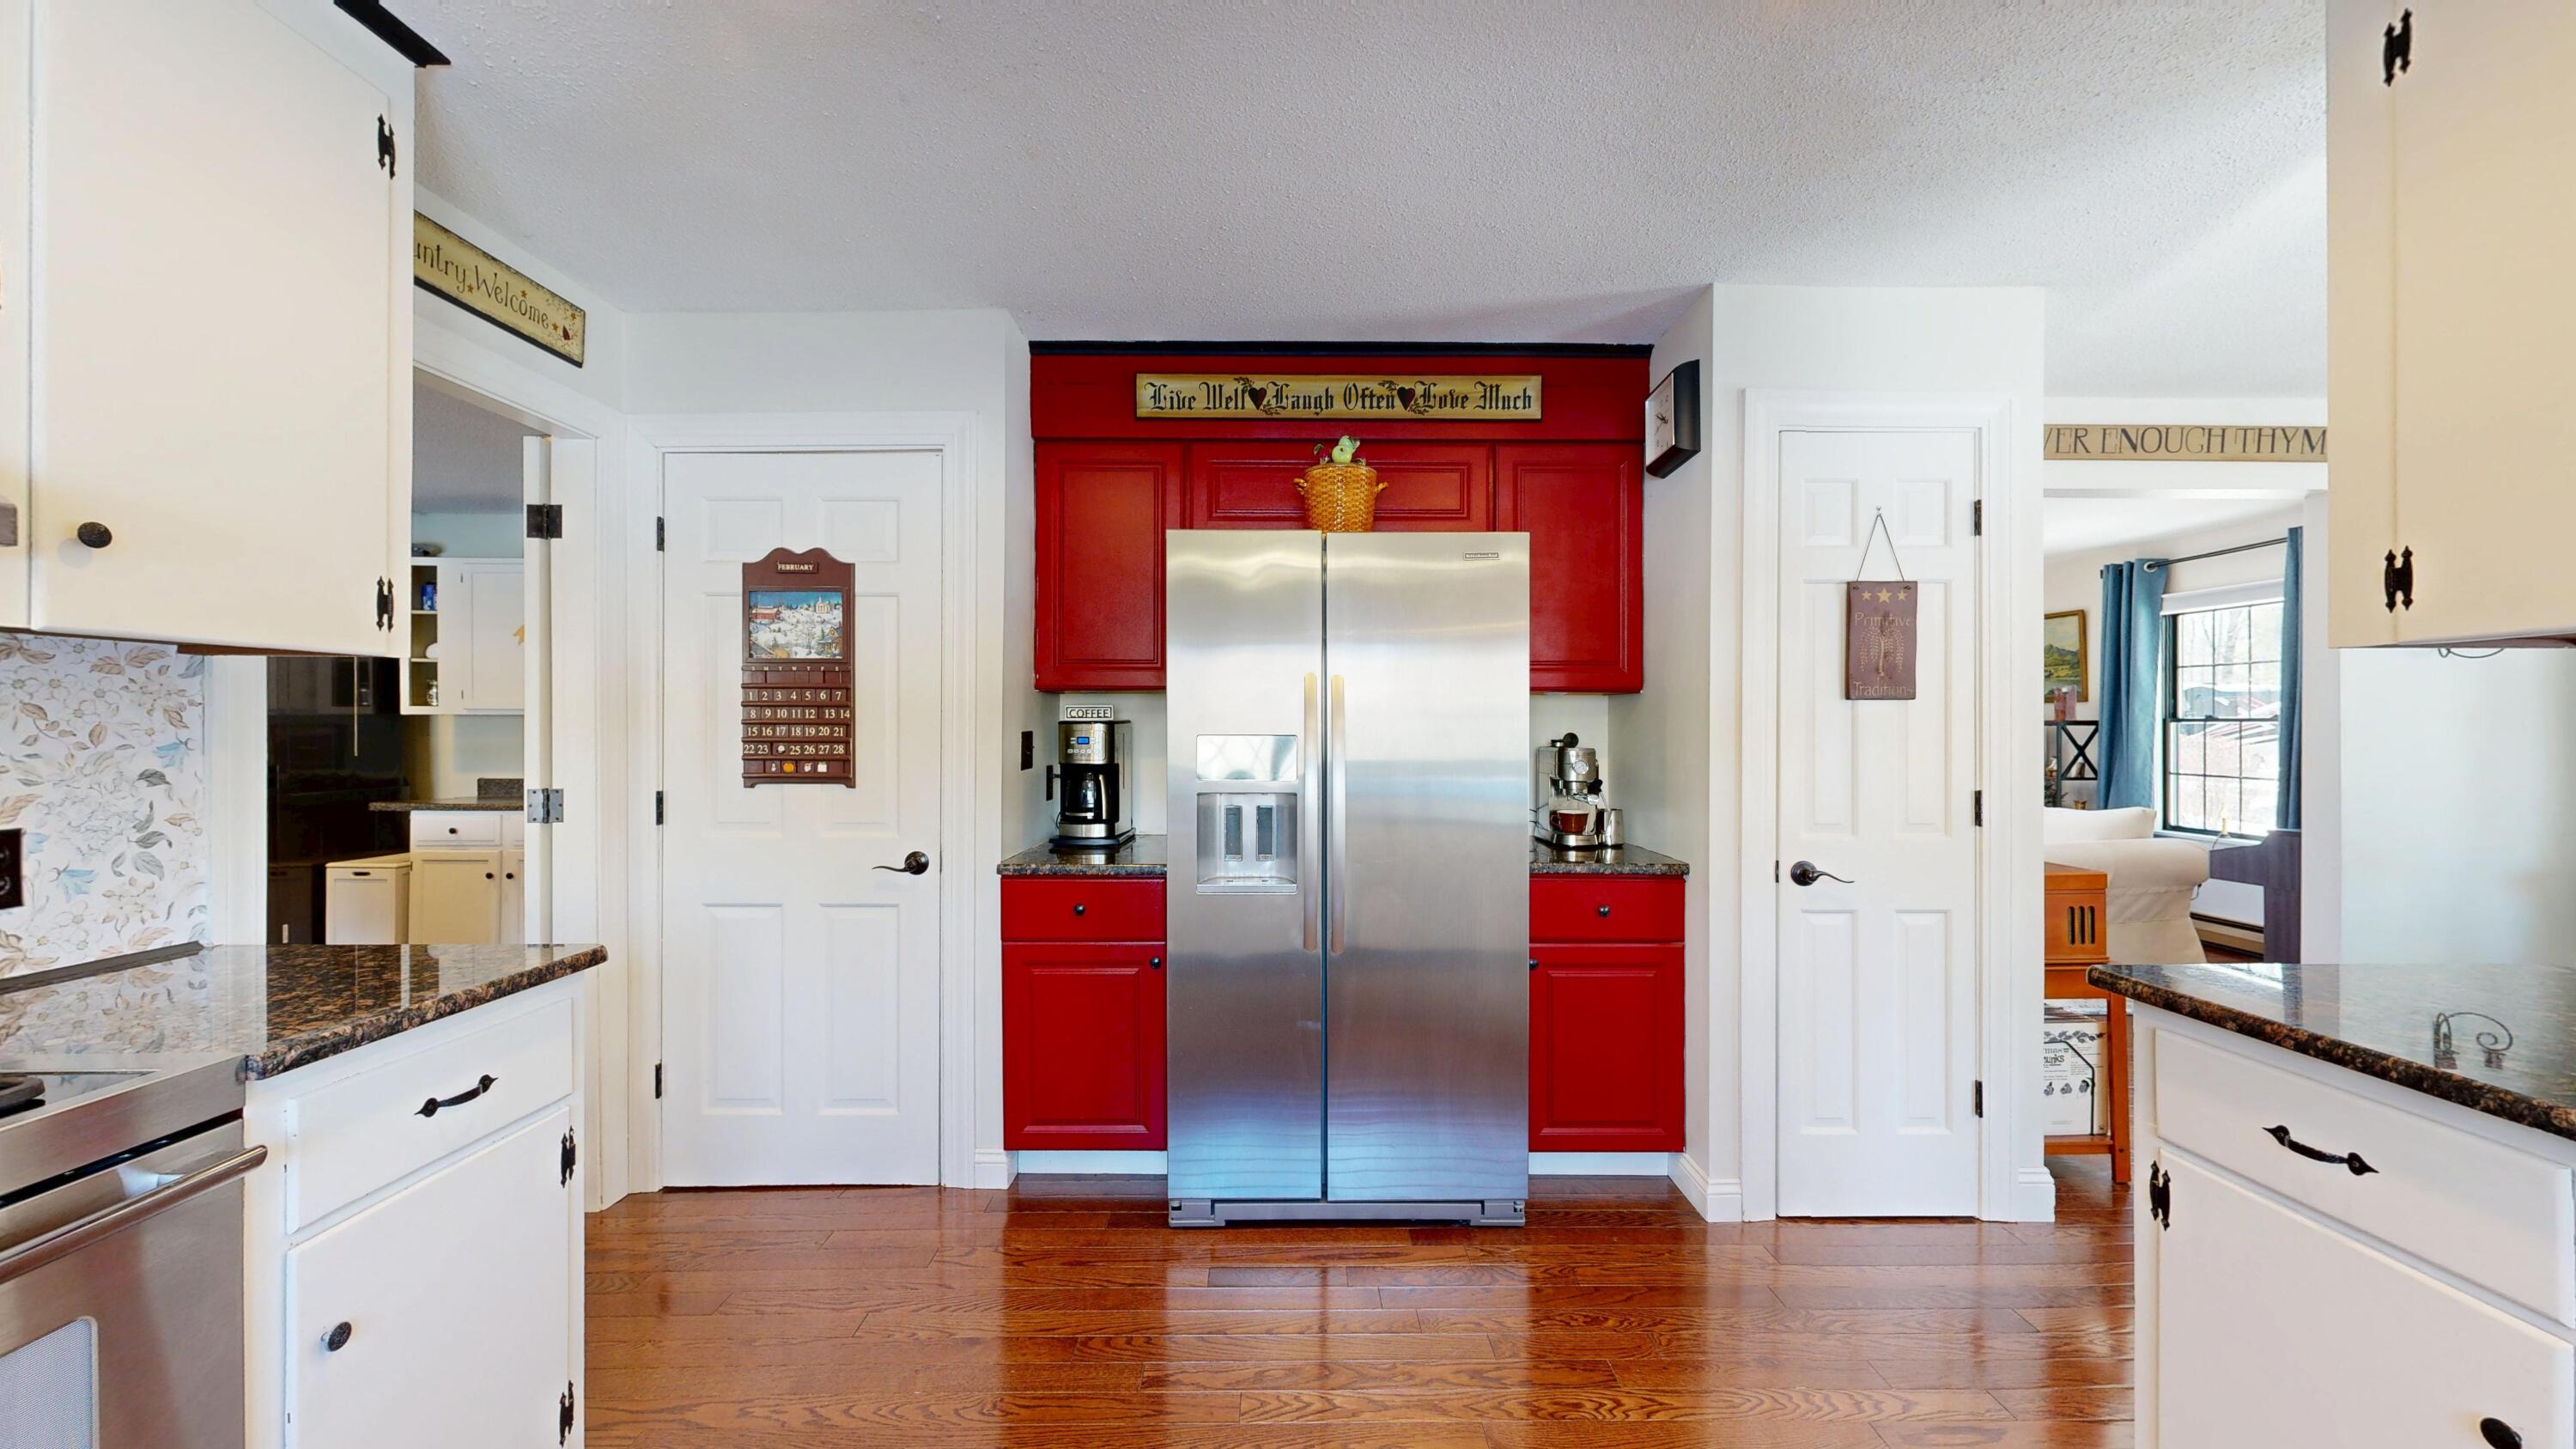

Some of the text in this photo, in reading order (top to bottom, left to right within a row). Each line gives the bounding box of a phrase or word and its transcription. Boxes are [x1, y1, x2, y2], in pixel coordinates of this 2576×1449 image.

[474, 265, 550, 329] Welcome
[1145, 381, 1532, 417] Live Well Laugh Often Love Much
[2100, 427, 2226, 454] ENOUGH
[2234, 428, 2327, 454] THYM
[1854, 612, 1912, 626] Primitive
[1853, 677, 1913, 697] Traditions
[749, 691, 841, 701] 1 2 3 4 5 6 7
[750, 709, 850, 718] 8 9 10 11 12 13 14
[1070, 709, 1109, 719] COFFEE
[747, 727, 843, 736] 15 16 17 18 19 20 21
[744, 745, 844, 754] 22 23 25 26 27 28
